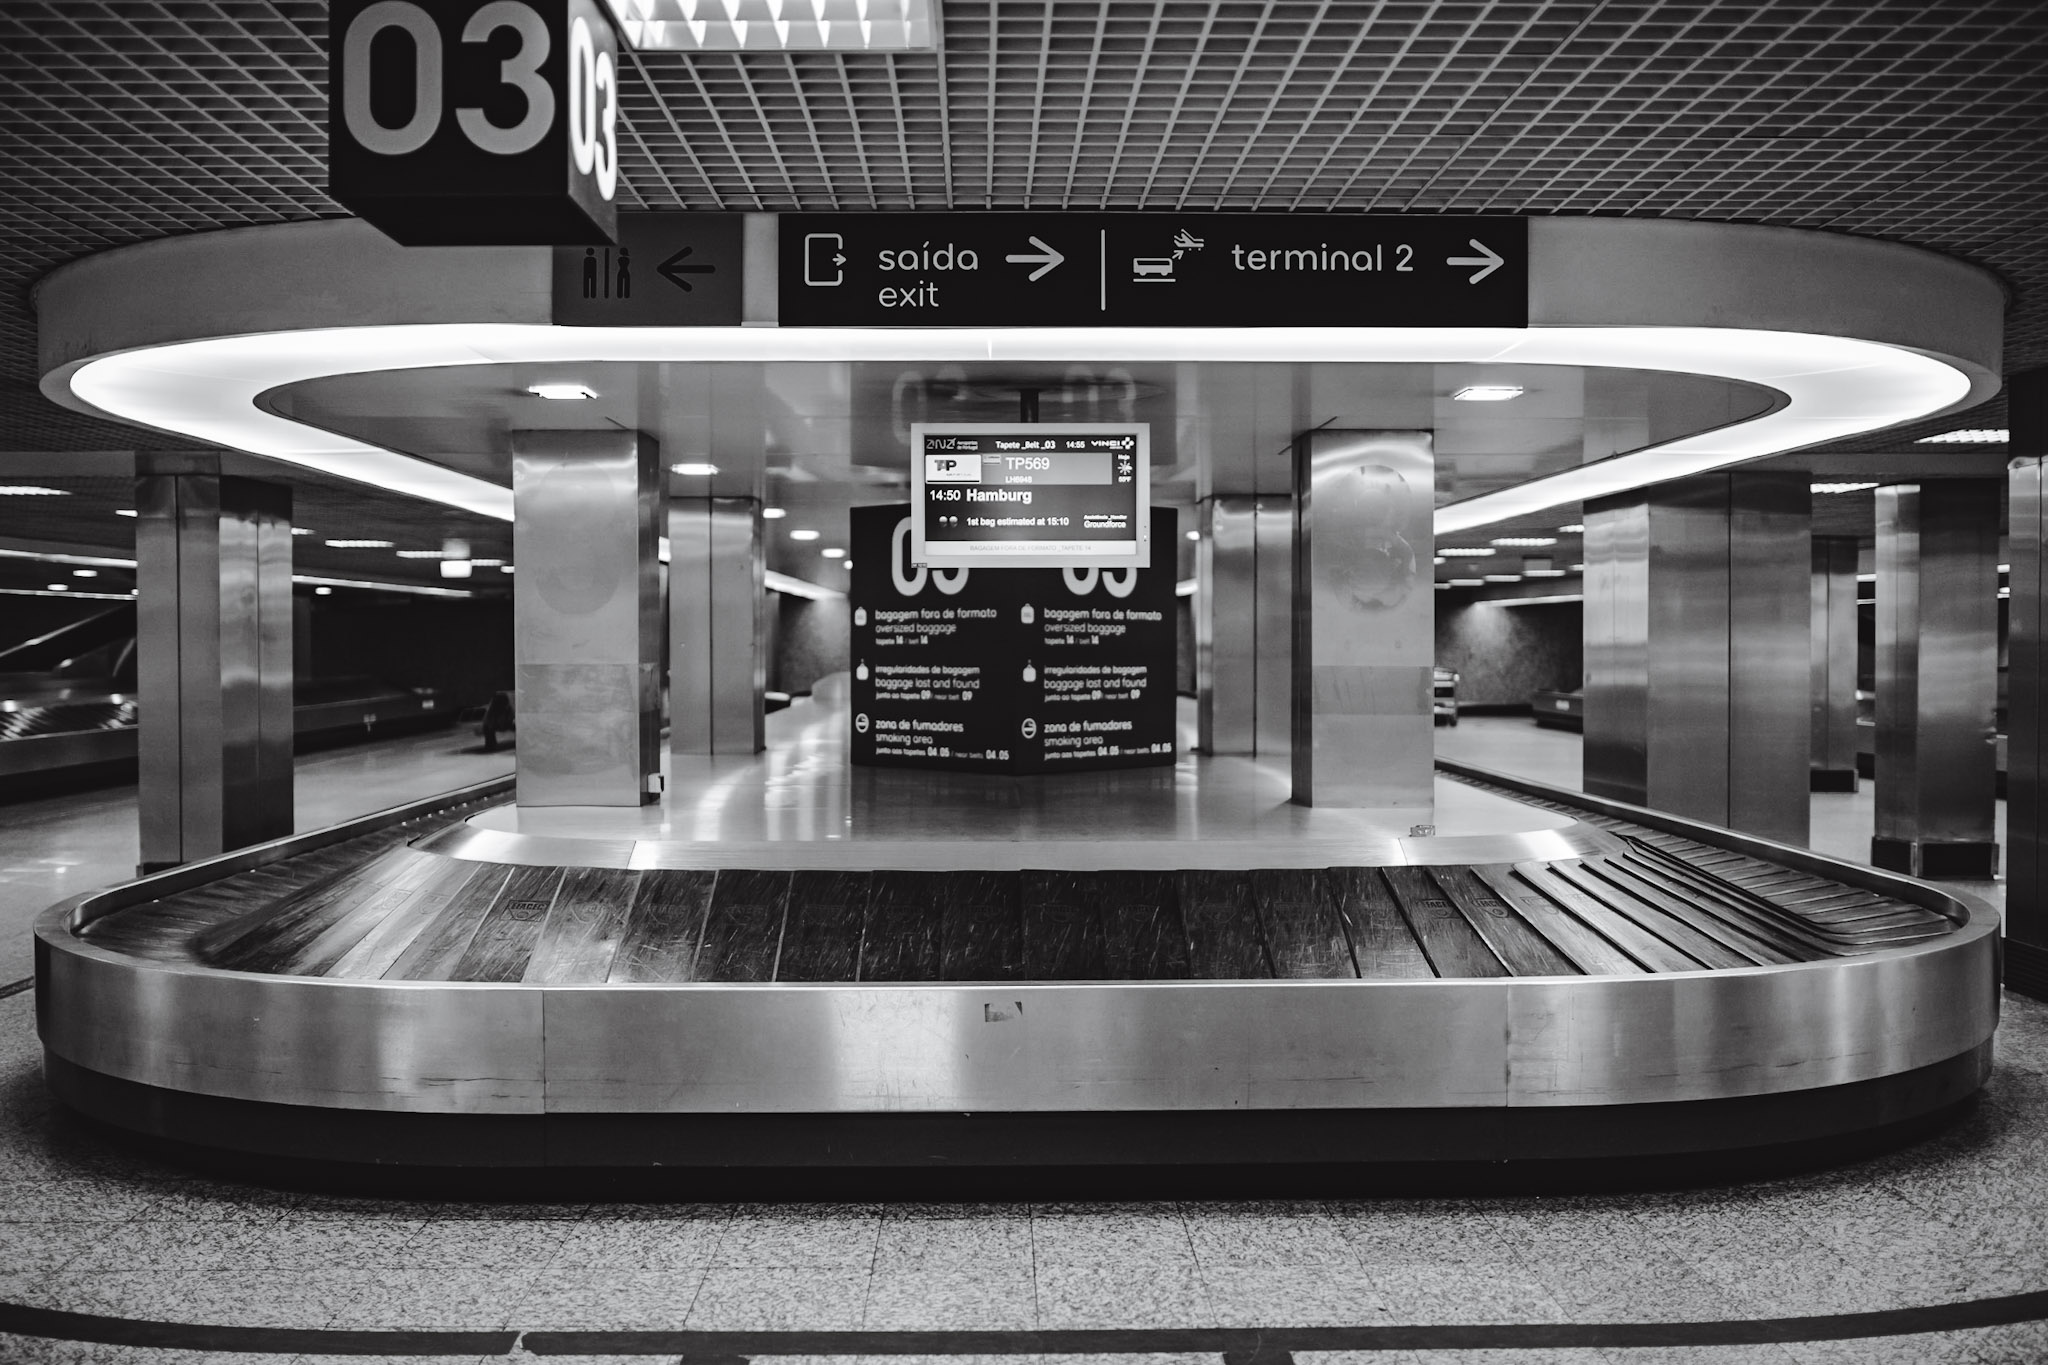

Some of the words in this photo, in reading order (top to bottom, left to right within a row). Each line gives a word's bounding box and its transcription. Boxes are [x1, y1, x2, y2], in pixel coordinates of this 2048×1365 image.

[343, 0, 556, 155] 03
[570, 15, 617, 202] 03
[878, 240, 978, 272] saída
[1232, 243, 1383, 272] terminal
[1396, 244, 1414, 272] 2
[878, 280, 939, 308] exit
[995, 440, 1020, 450] Tapete
[1066, 441, 1086, 449] 14:55
[934, 460, 957, 472] TAP
[1005, 457, 1050, 470] TP569
[930, 490, 961, 501] 14:50
[966, 488, 1032, 504] Hamburg
[967, 517, 979, 526] 1st
[980, 517, 995, 527] bag
[997, 517, 1035, 526] estimated
[1037, 518, 1045, 526] at
[1046, 517, 1069, 526] 15:10
[1084, 520, 1126, 528] Groundforce
[875, 609, 918, 622] bagagem
[921, 608, 940, 619] fora
[942, 608, 955, 619] de
[957, 607, 997, 618] formato
[1044, 608, 1089, 621] bagagem
[1092, 608, 1111, 620] fora
[1113, 609, 1124, 620] de
[1126, 609, 1162, 621] formato
[875, 624, 915, 633] oversized
[917, 623, 957, 635] baggage
[1044, 623, 1086, 633] oversized
[1087, 623, 1126, 635] baggage
[875, 665, 930, 675] irregularidades
[931, 666, 941, 674] de
[942, 666, 980, 676] bagagem
[1044, 665, 1100, 676] irregularidades
[1102, 666, 1112, 674] de
[1113, 666, 1147, 676] bagagem
[875, 677, 913, 690] baggage
[915, 678, 930, 688] lost
[933, 679, 950, 688] and
[953, 679, 980, 689] found
[1044, 679, 1084, 691] baggage
[1086, 678, 1101, 688] lost
[1103, 678, 1120, 688] and
[1122, 677, 1147, 688] found
[921, 690, 931, 700] 09
[962, 691, 973, 701] 09
[1092, 690, 1101, 700] 09
[1130, 689, 1141, 699] 09
[876, 720, 897, 729] zona
[899, 720, 910, 730] de
[912, 719, 964, 732] fumadores
[1044, 723, 1067, 733] zona
[1068, 721, 1081, 732] de
[1083, 720, 1132, 731] fumadores
[876, 733, 911, 746] smoking
[913, 735, 933, 744] area
[1044, 736, 1082, 748] smoking
[1083, 736, 1104, 745] area
